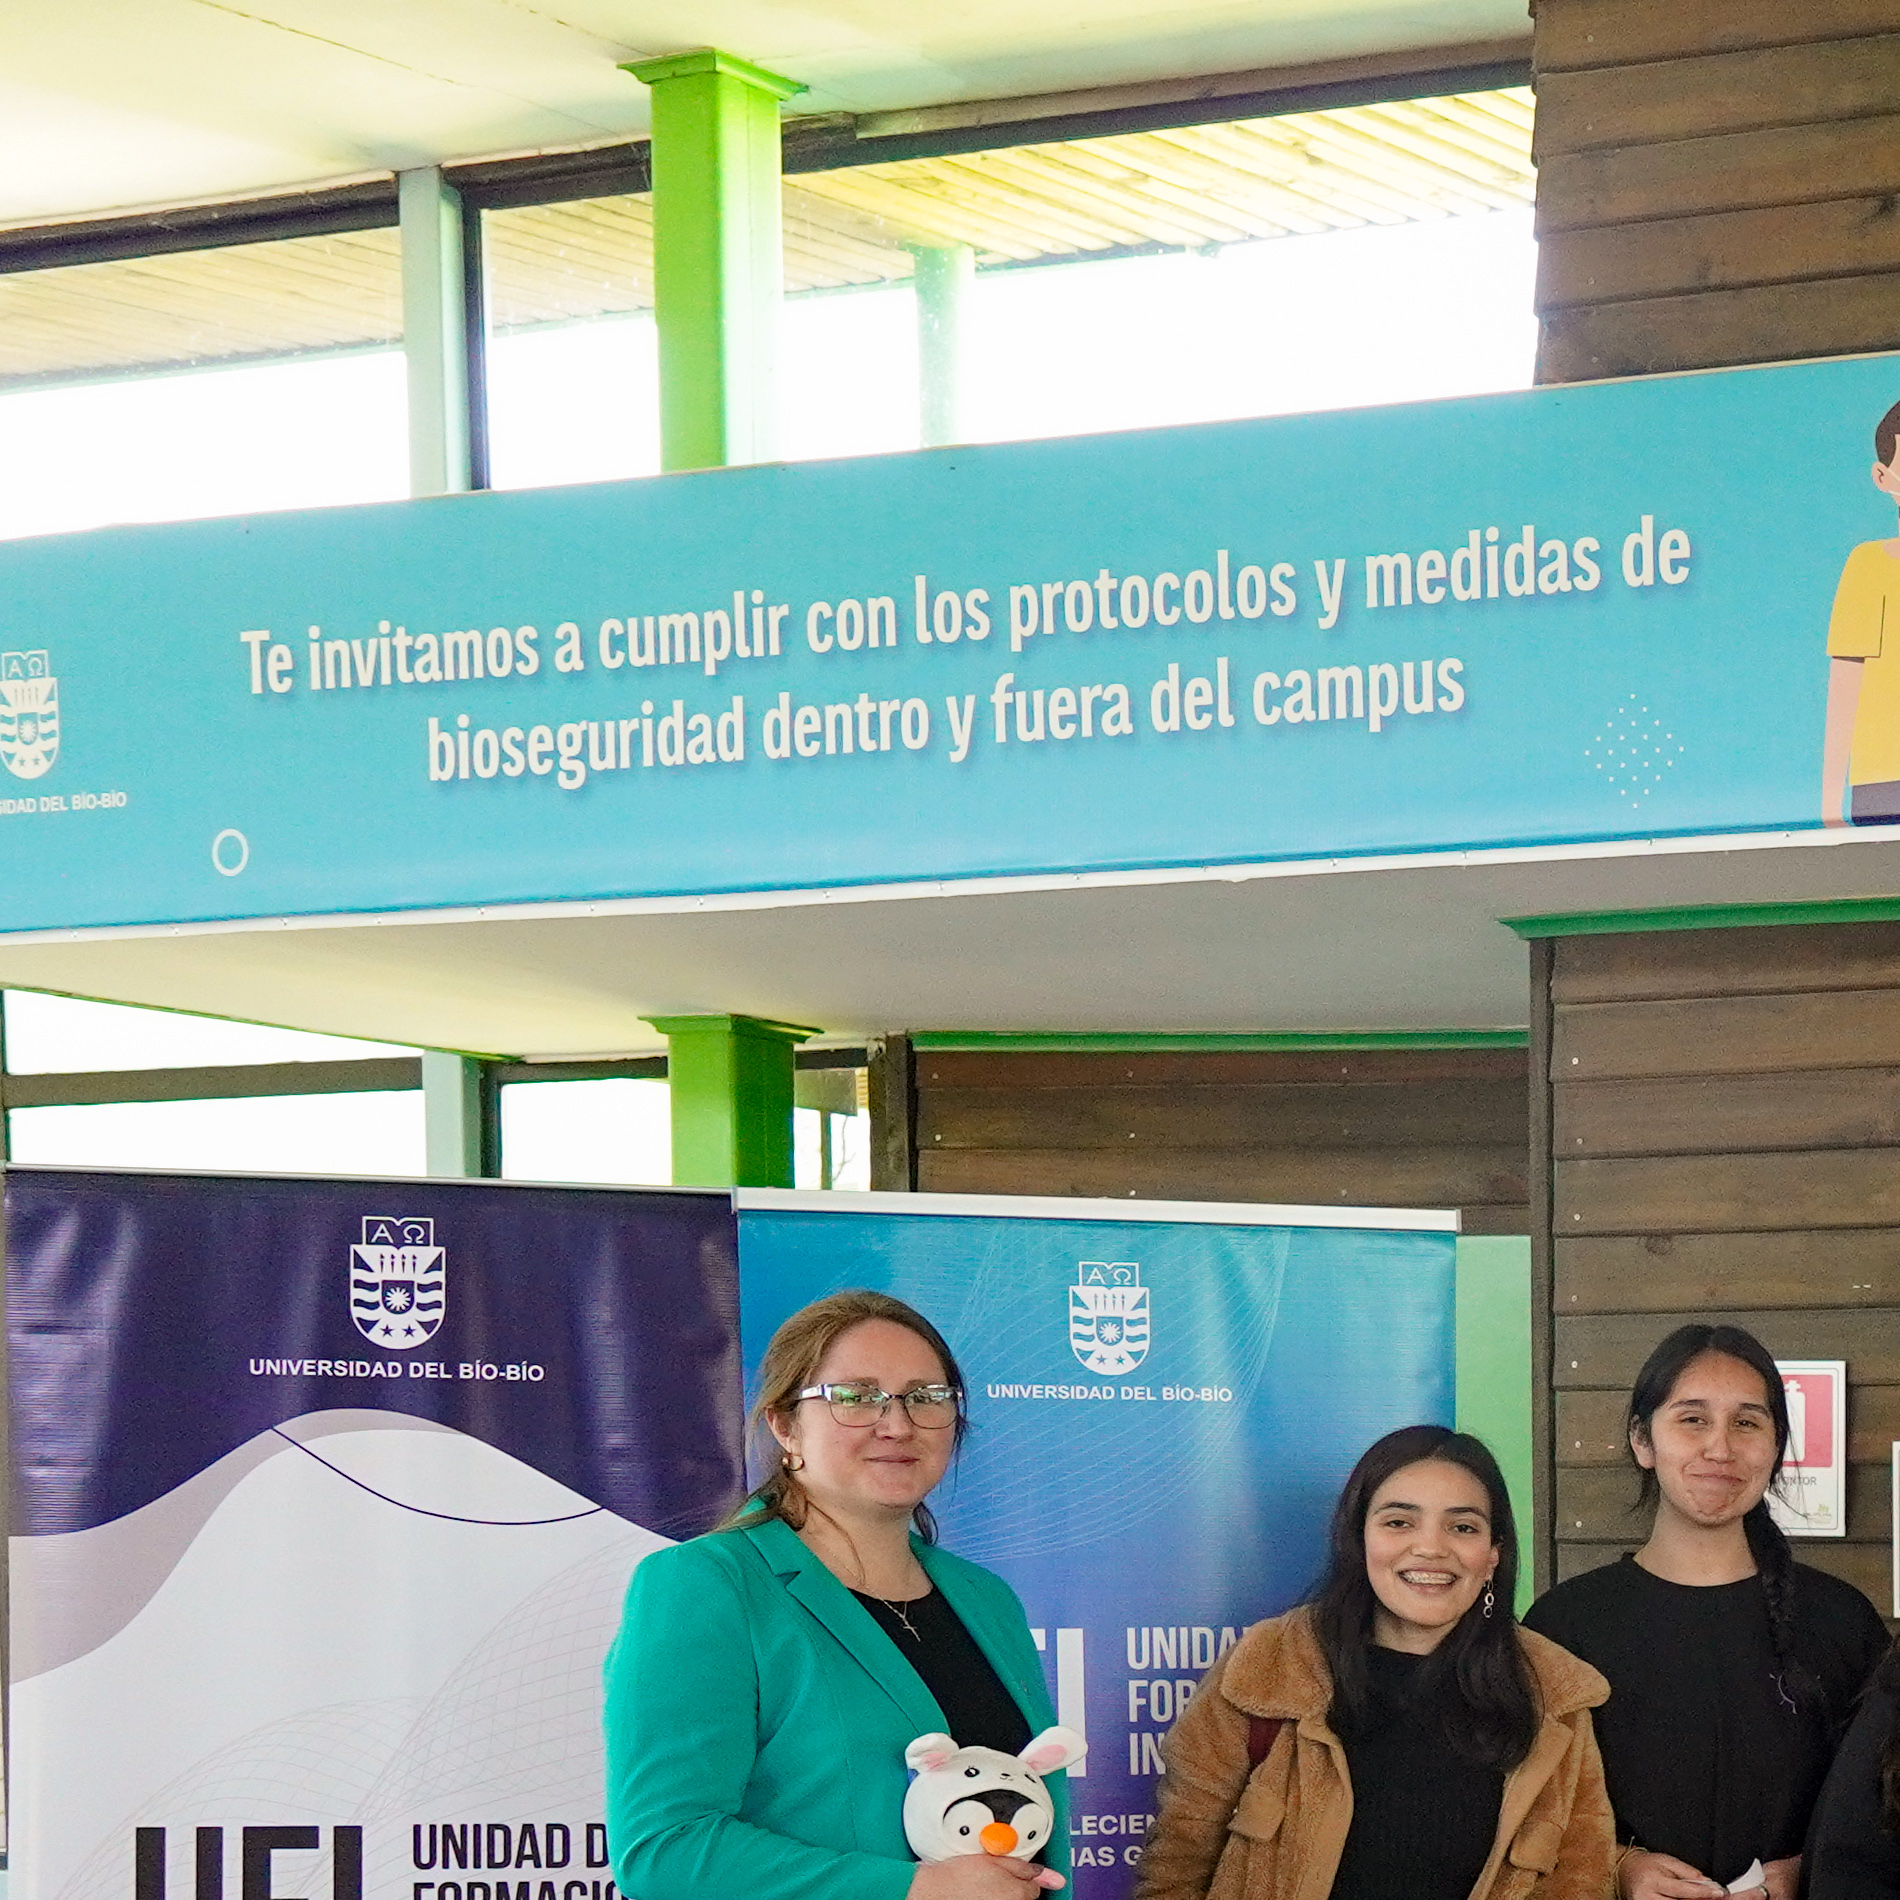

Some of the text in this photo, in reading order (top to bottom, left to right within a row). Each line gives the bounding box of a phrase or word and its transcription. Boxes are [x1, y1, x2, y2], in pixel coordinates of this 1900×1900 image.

[241, 514, 1691, 695] Te invitamos a cumplir con los protocolos y medidas de
[428, 656, 1465, 790] bioseguridad dentro y fuera del campus
[40, 795, 68, 812] DEL
[249, 1358, 545, 1382] UNIVERSIDAD DEL BÍO-BÍO
[987, 1381, 1233, 1403] UNIVERSIDAD DEL BÍO-BÍO
[412, 1823, 609, 1869] UNIDAD D
